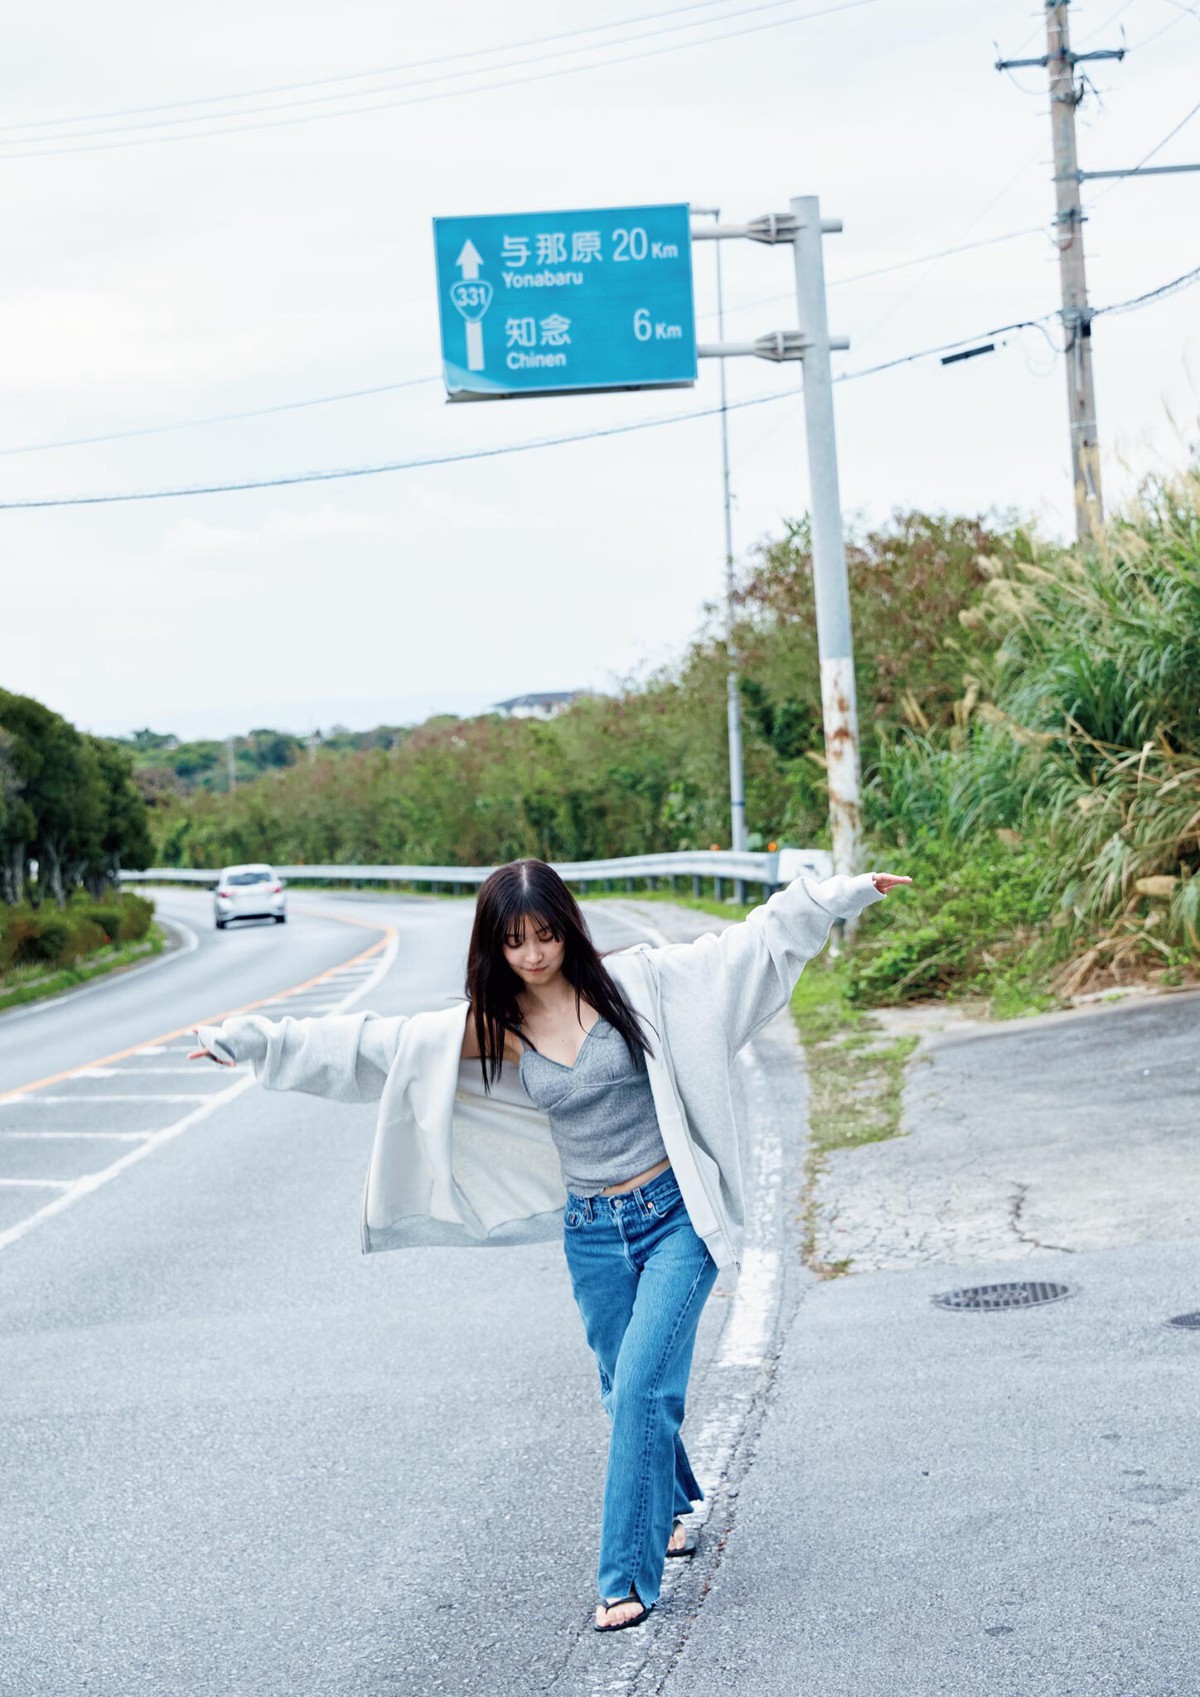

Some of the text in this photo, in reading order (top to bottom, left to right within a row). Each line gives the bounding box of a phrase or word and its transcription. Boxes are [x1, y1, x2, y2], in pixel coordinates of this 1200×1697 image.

[501, 231, 602, 267] 与那原
[612, 227, 648, 261] 20
[502, 270, 583, 288] Yonabaru
[456, 287, 486, 307] 331
[506, 314, 571, 347] 知念
[633, 308, 652, 341] 6
[506, 352, 566, 369] Chinen
